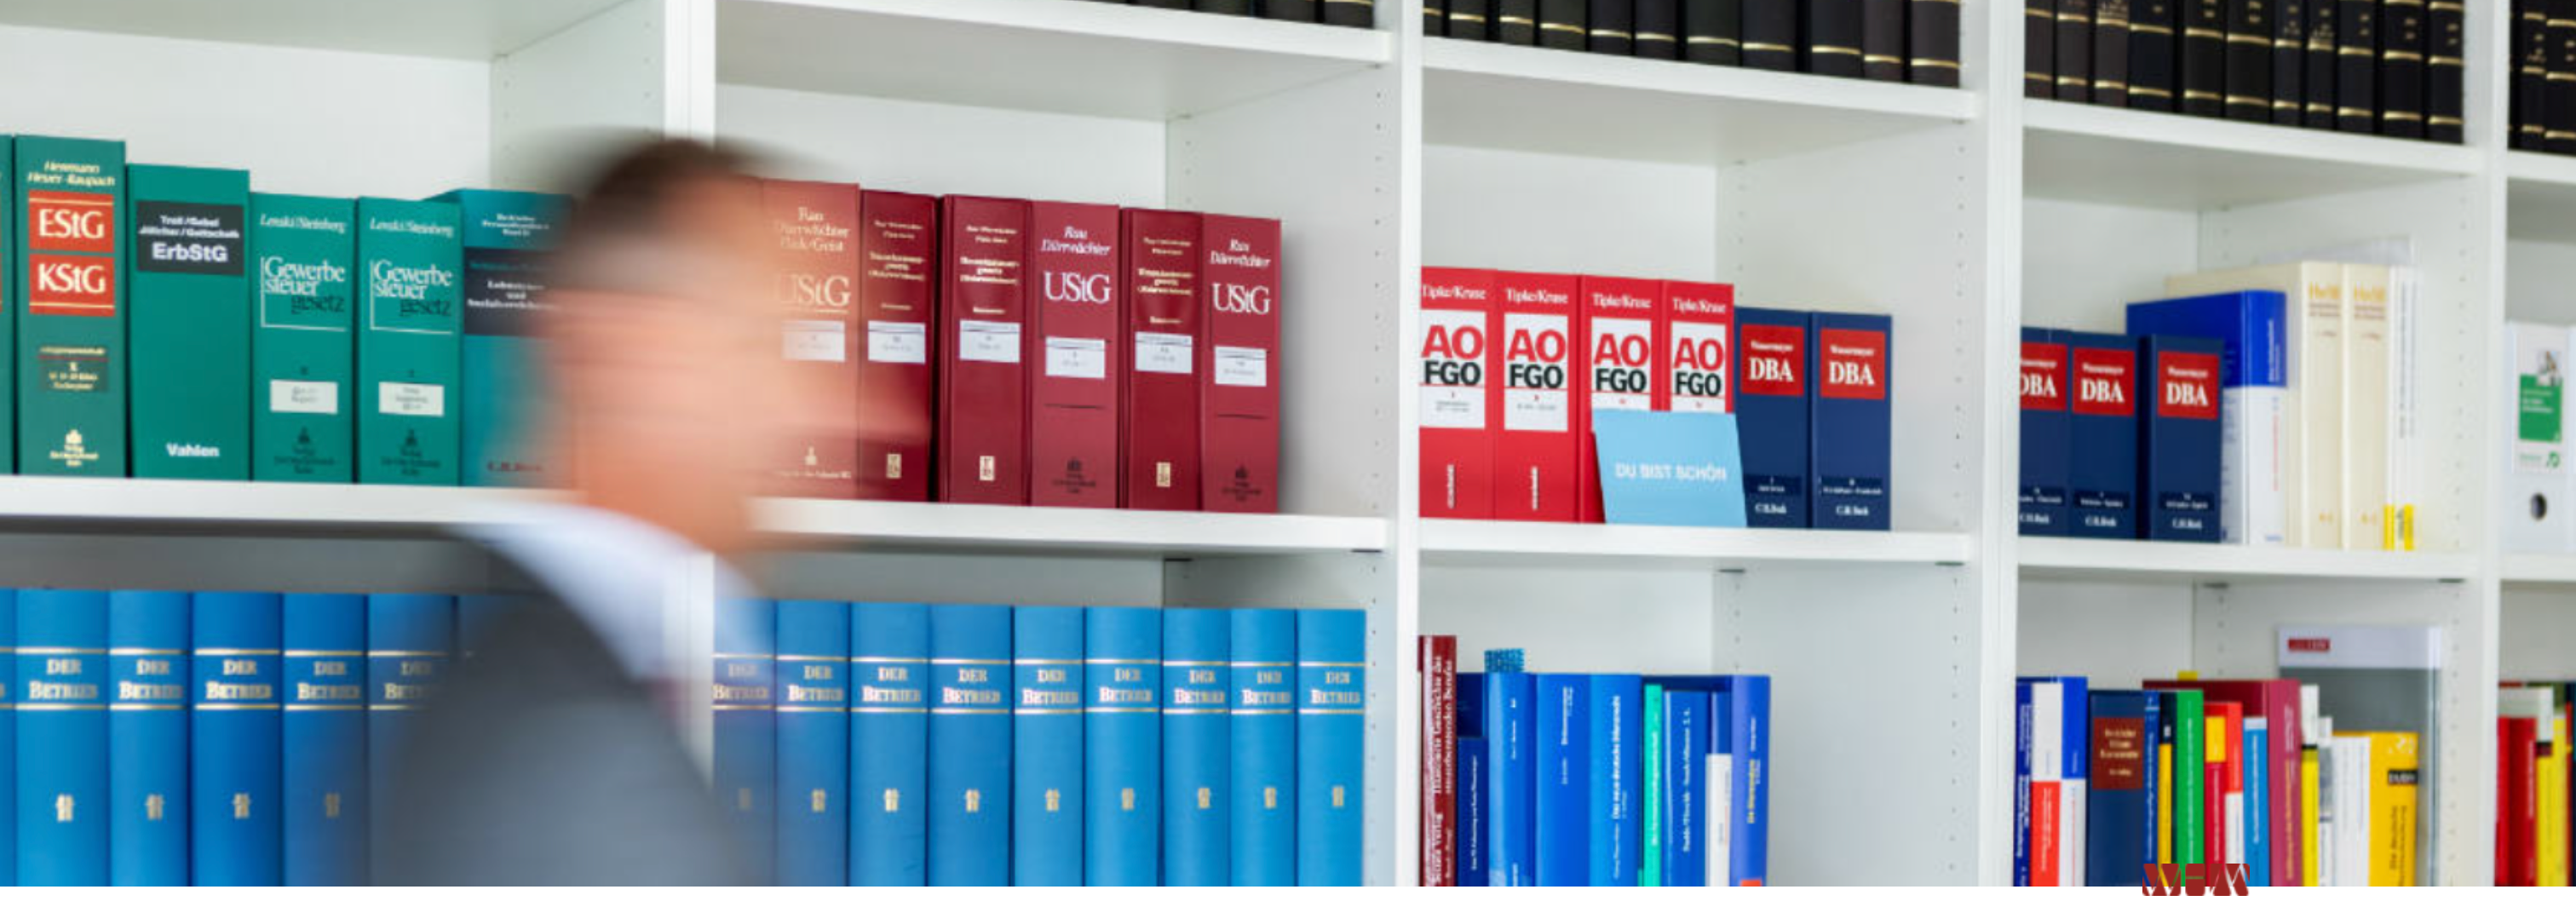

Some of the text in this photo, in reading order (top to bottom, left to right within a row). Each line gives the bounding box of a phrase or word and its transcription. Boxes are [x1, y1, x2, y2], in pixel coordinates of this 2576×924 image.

[39, 209, 104, 238] EStG
[152, 242, 228, 262] ErbStG
[38, 263, 106, 293] KStG
[265, 256, 345, 283] Gewerbe
[373, 260, 453, 286] Gewerbe
[266, 278, 319, 296] steuer
[375, 282, 426, 300] steuer
[1044, 272, 1112, 303] UStG
[290, 296, 344, 315] gesetz
[399, 300, 451, 317] gesetz
[1213, 283, 1271, 314] UStG
[1422, 325, 1484, 359] AO
[1507, 330, 1567, 363] AO
[1594, 333, 1648, 367] AO
[1673, 338, 1724, 370] AO
[1424, 360, 1481, 386] FGO
[1509, 364, 1563, 388] FGO
[1749, 358, 1793, 382] DBA
[1829, 361, 1874, 386] DBA
[1596, 368, 1647, 393] FGO
[1676, 371, 1721, 397] FGO
[2081, 379, 2124, 402] DBA
[2166, 382, 2208, 406] DBA
[166, 443, 219, 458] Vahlen
[1615, 464, 1727, 481] DU BIST SCHÖN
[47, 659, 81, 675] DER
[136, 660, 169, 675] DER
[223, 660, 257, 675] DER
[313, 662, 346, 675] DER
[804, 666, 832, 679] DER
[878, 667, 907, 680] DER
[958, 669, 987, 682] DER
[1038, 669, 1066, 682] DER
[1115, 668, 1141, 680] DER
[1189, 670, 1216, 683] DER
[1257, 671, 1281, 683] DER
[1325, 672, 1350, 683] DER
